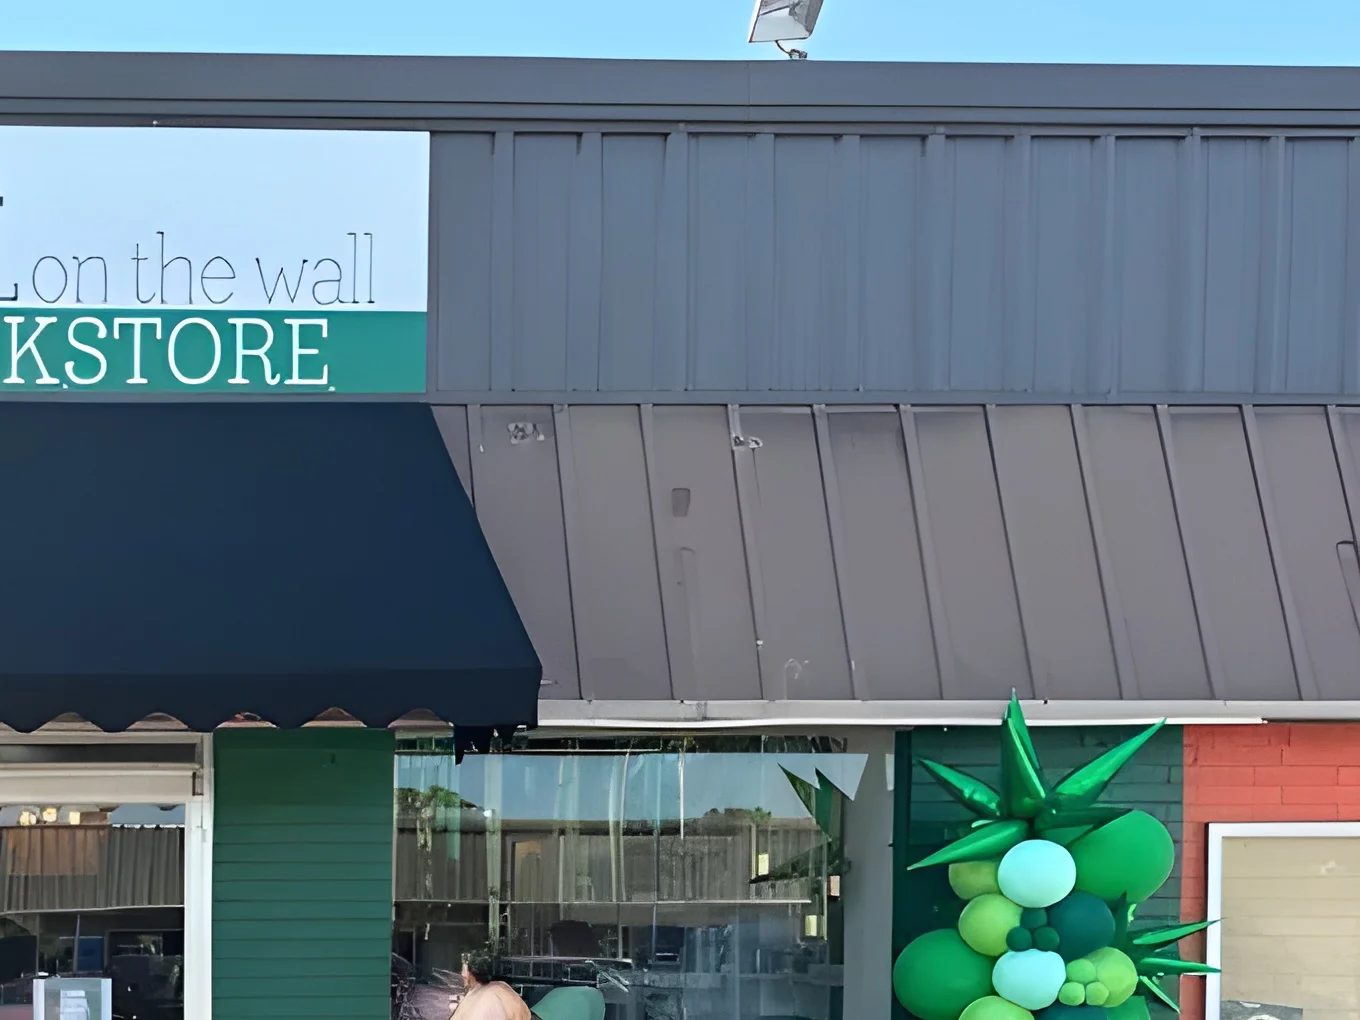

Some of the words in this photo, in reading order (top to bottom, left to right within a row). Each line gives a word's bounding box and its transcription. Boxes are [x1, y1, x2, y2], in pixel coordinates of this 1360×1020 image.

[32, 252, 108, 304] on
[131, 231, 236, 304] the
[255, 232, 375, 305] wall
